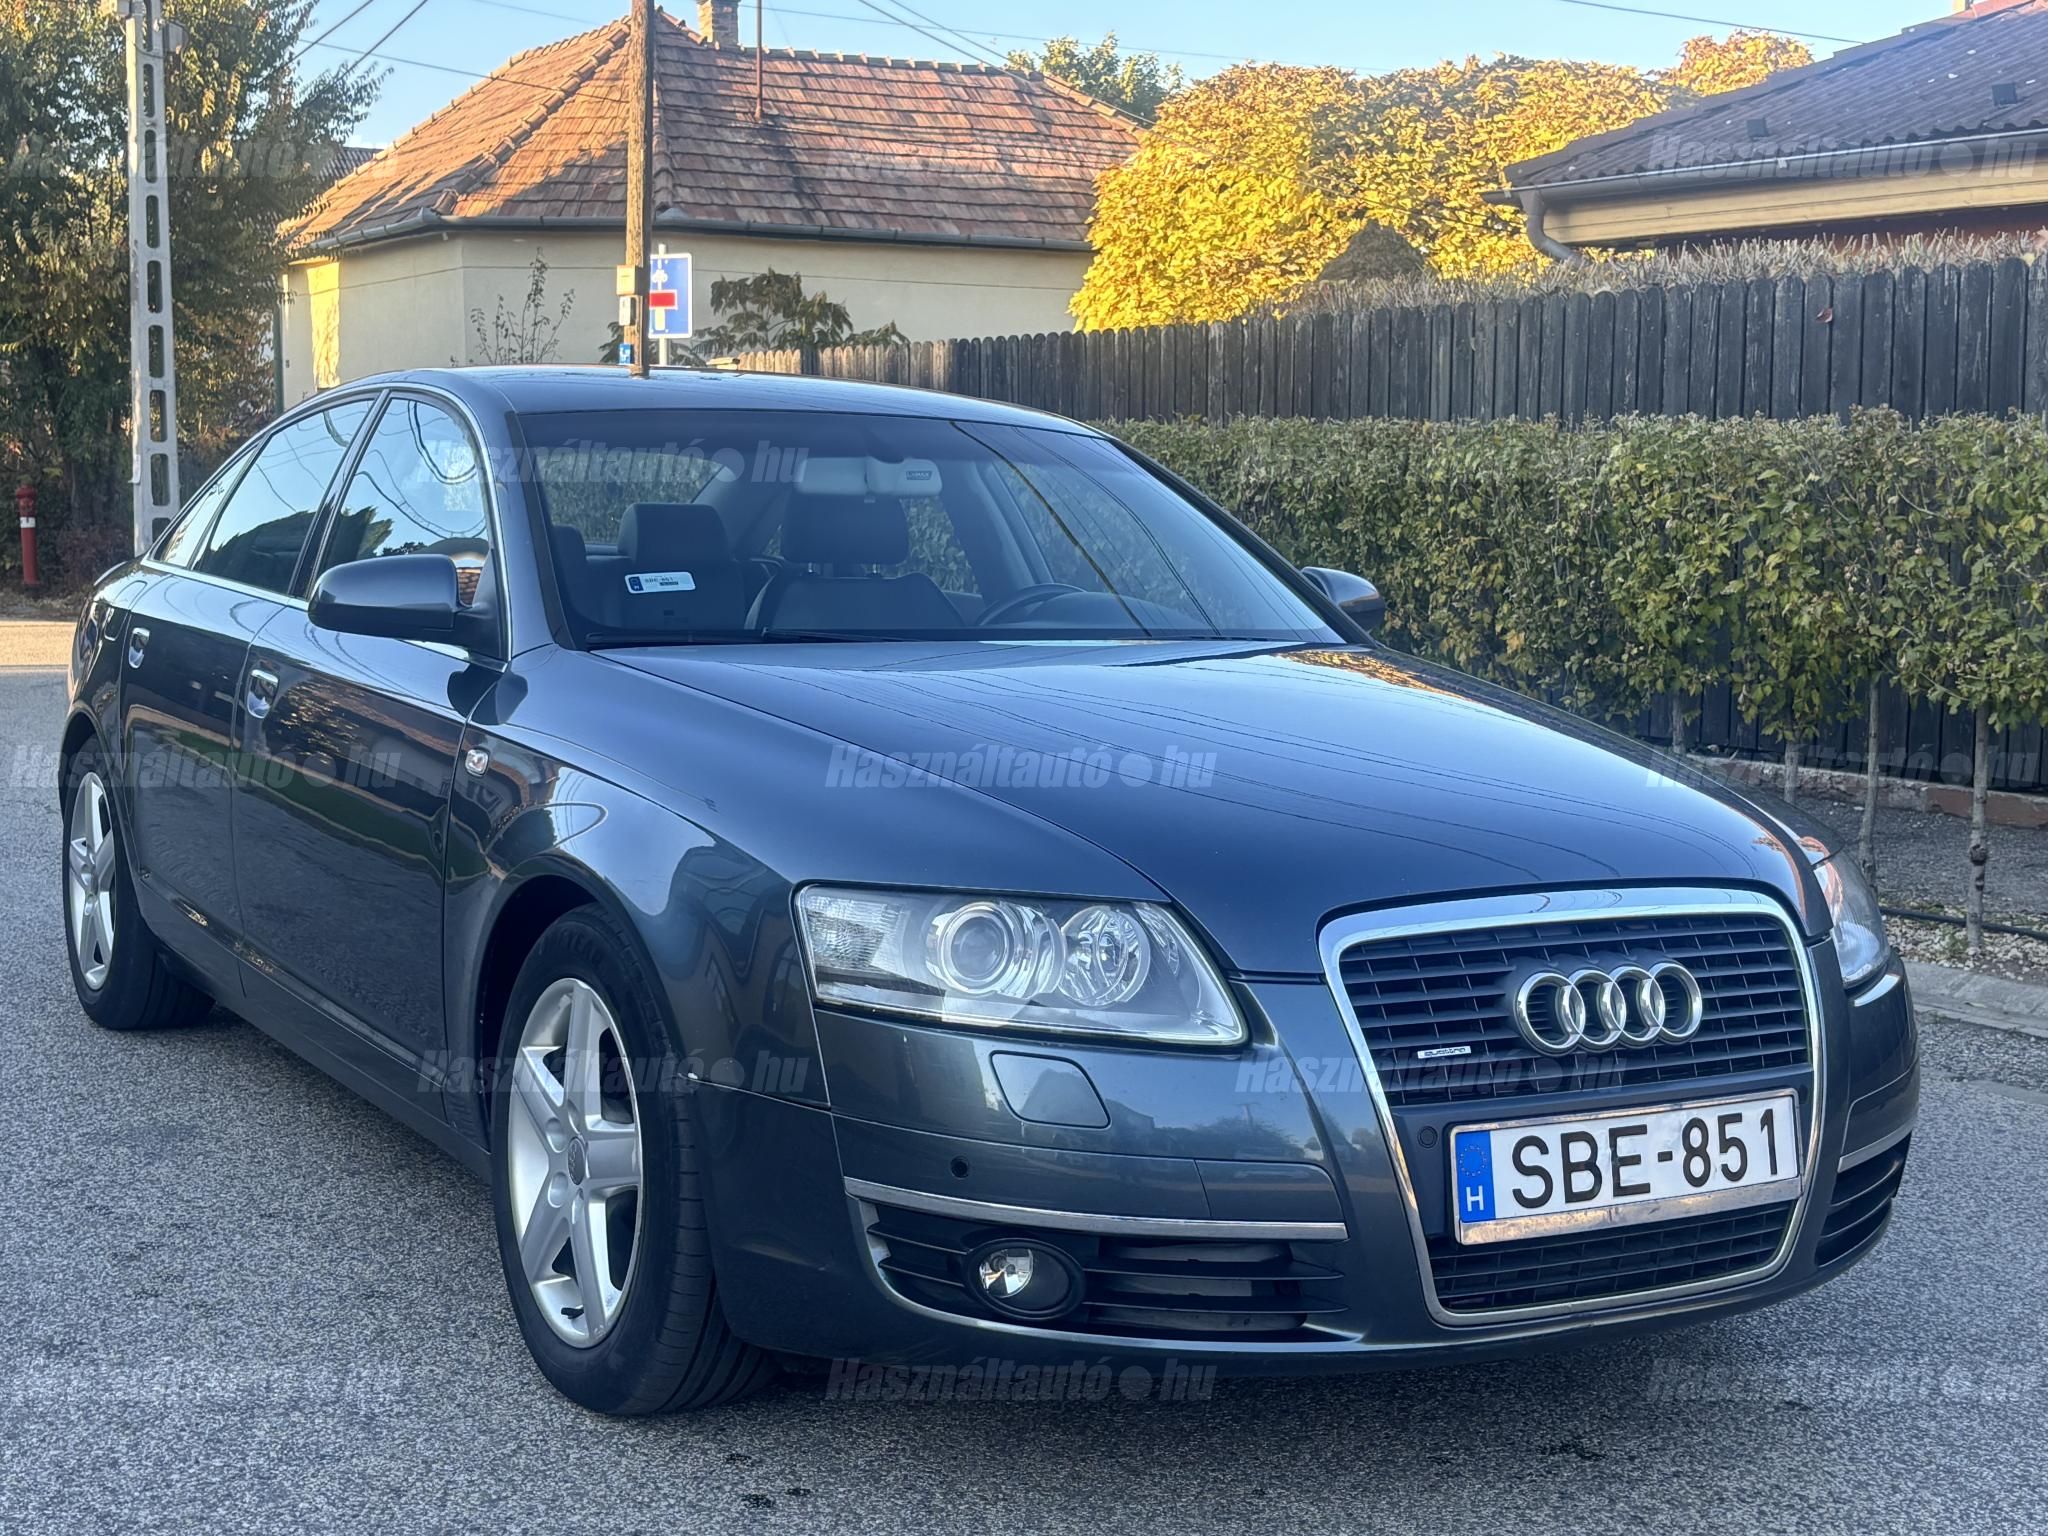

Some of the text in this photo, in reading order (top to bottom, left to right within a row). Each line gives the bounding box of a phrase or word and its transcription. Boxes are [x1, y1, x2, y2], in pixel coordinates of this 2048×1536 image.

[1424, 1047, 1466, 1057] quattro
[1512, 1108, 1778, 1209] SBE-851
[1466, 1185, 1484, 1211] H
